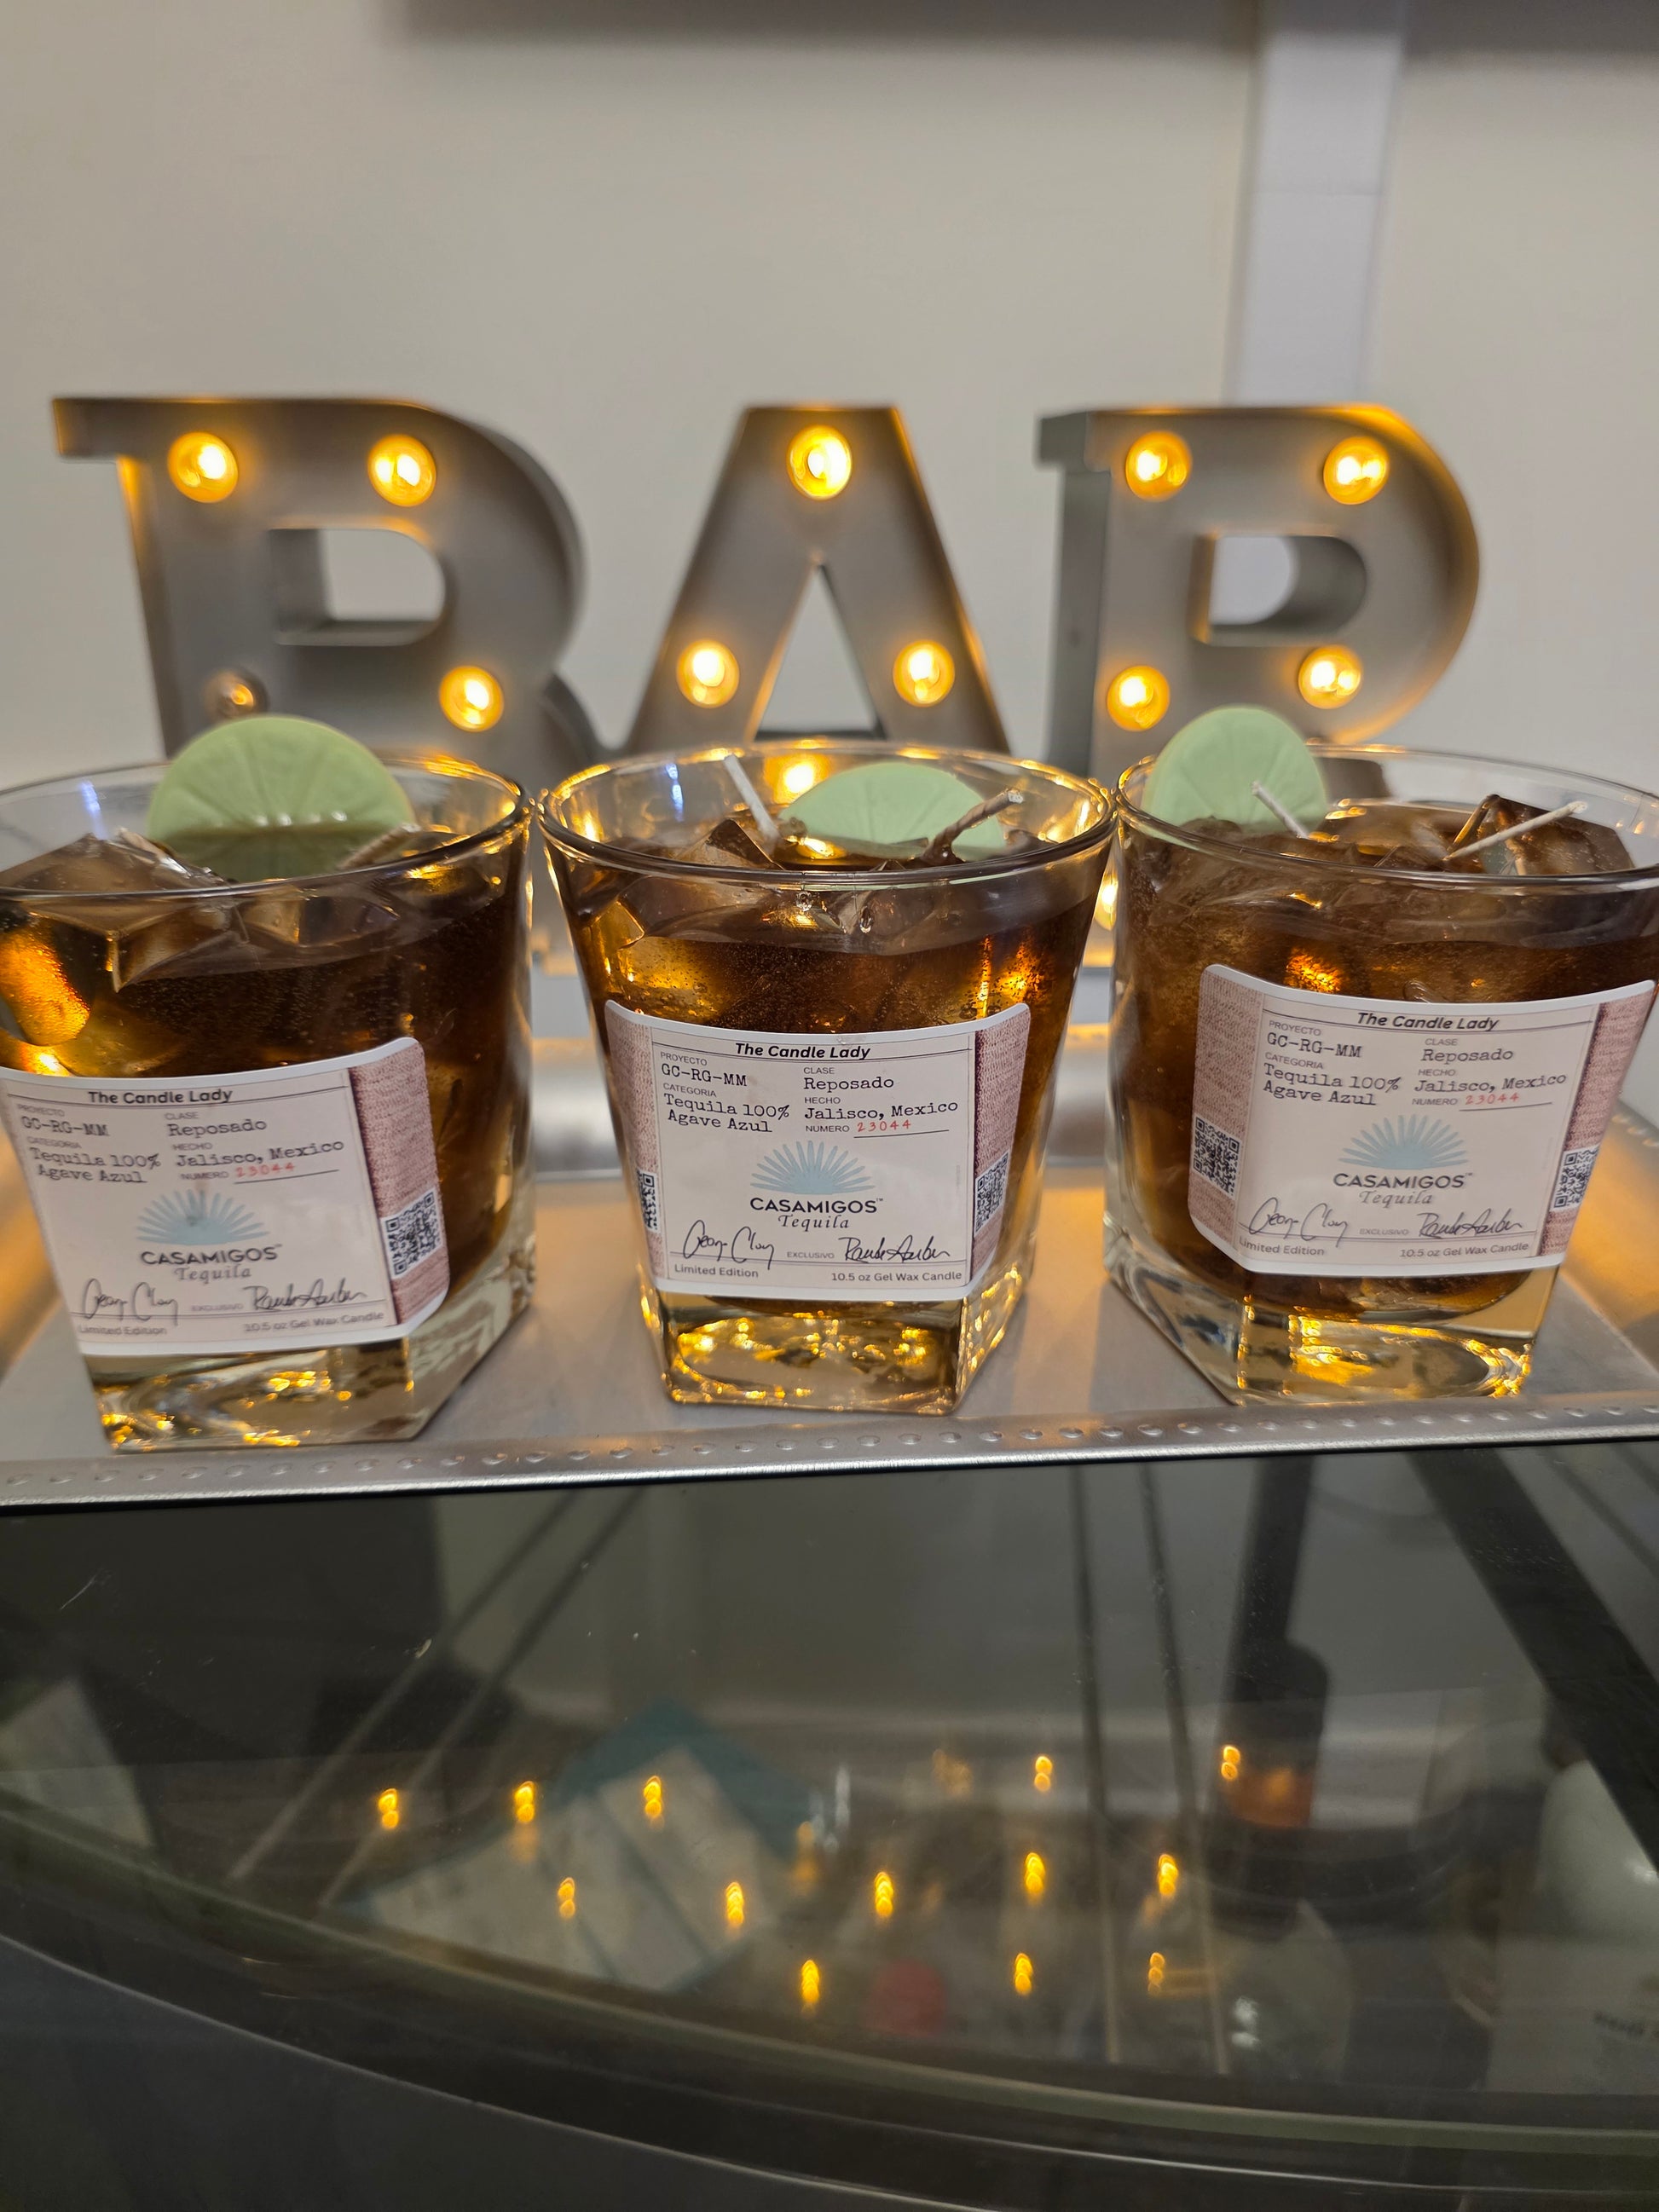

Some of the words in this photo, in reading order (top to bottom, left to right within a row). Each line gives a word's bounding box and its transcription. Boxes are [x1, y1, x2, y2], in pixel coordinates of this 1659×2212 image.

[1269, 1019, 1321, 1037] PROYECTO
[1358, 1013, 1388, 1026] The
[1392, 1015, 1455, 1030] Candle
[1456, 1017, 1500, 1031] Lady
[660, 1051, 708, 1066] PROYECTO
[736, 1042, 764, 1056] The
[768, 1045, 825, 1058] Candle
[830, 1046, 870, 1060] Lady
[1265, 1052, 1323, 1069] CATEGORIA
[1420, 1048, 1514, 1065] Reposado
[662, 1063, 748, 1087] GC-RG-MM
[1263, 1063, 1343, 1087] Tequila
[1348, 1076, 1402, 1094] 100%
[1414, 1079, 1495, 1093] Jalisco,
[1502, 1073, 1567, 1090] Mexico
[663, 1083, 717, 1098] CATEGORIA
[804, 1077, 894, 1093] Reposado
[1263, 1080, 1321, 1101] Agave
[1327, 1090, 1377, 1106] Azul
[89, 1091, 118, 1104] The
[123, 1091, 183, 1104] Candle
[190, 1089, 233, 1104] Lady
[1412, 1097, 1458, 1106] NUMERO
[1465, 1093, 1520, 1106] 23044
[663, 1093, 737, 1115] Tequila
[743, 1104, 789, 1121] 100%
[804, 1107, 885, 1121] Jalisco,
[891, 1101, 958, 1118] Mexico
[167, 1118, 267, 1139] Reposado
[668, 1109, 721, 1128] Agave
[727, 1118, 772, 1133] Azul
[857, 1118, 911, 1133] 23044
[29, 1147, 106, 1166] Tequila
[111, 1153, 161, 1170] 100%
[176, 1153, 264, 1167] Jalisco,
[269, 1141, 344, 1160] Mexico
[38, 1164, 93, 1181] Agave
[99, 1170, 147, 1183] Azul
[1359, 1189, 1433, 1209] Tequila
[777, 1214, 850, 1233] Tequila
[1240, 1236, 1280, 1255] Limited
[1283, 1245, 1324, 1256] Edition
[1400, 1249, 1424, 1257] 10.5
[1443, 1247, 1461, 1256] Gel
[1465, 1246, 1487, 1255] Wax
[1492, 1243, 1529, 1253] Candle
[174, 1264, 251, 1285] Tequila
[674, 1263, 716, 1275] Limited
[720, 1268, 759, 1278] Edition
[831, 1273, 855, 1281] 10.5
[874, 1272, 893, 1282] Gel
[895, 1273, 919, 1281] Wax
[922, 1270, 962, 1281] Candle
